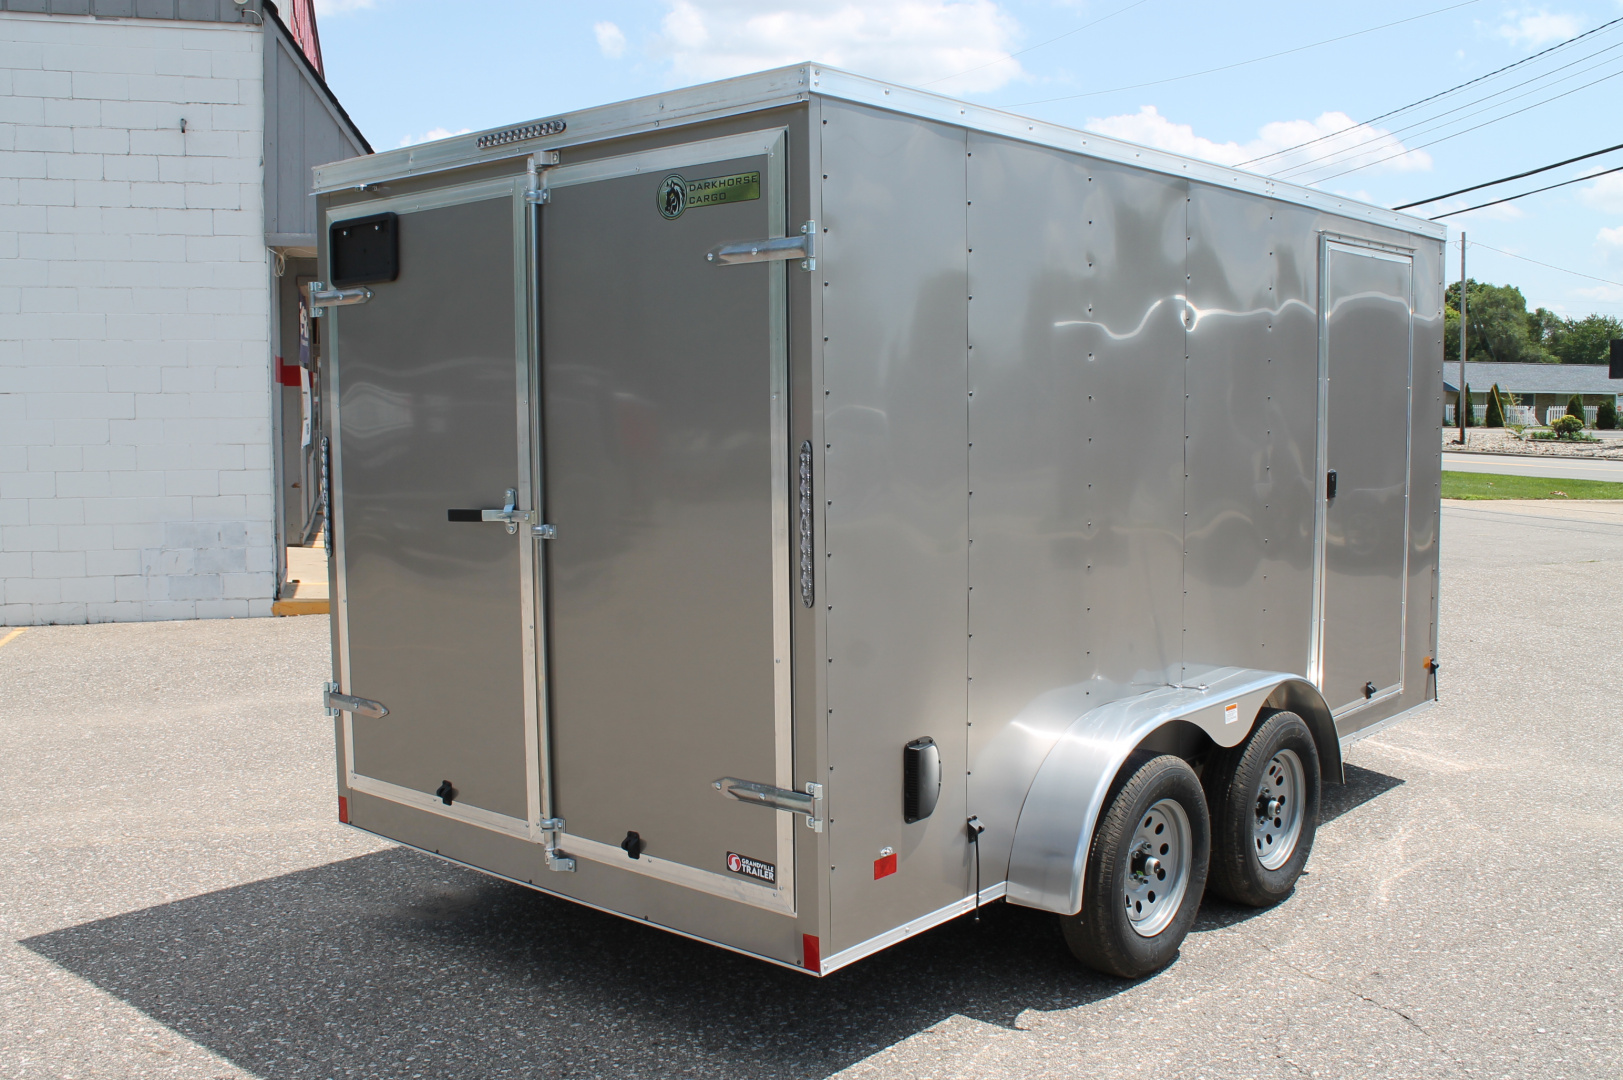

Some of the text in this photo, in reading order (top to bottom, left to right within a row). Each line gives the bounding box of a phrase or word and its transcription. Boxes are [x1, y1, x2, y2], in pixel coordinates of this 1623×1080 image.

[689, 175, 758, 192] DARKHORSE
[689, 192, 727, 204] CARGO
[741, 858, 774, 872] GRANDVILLE
[741, 864, 774, 881] TRAILER
